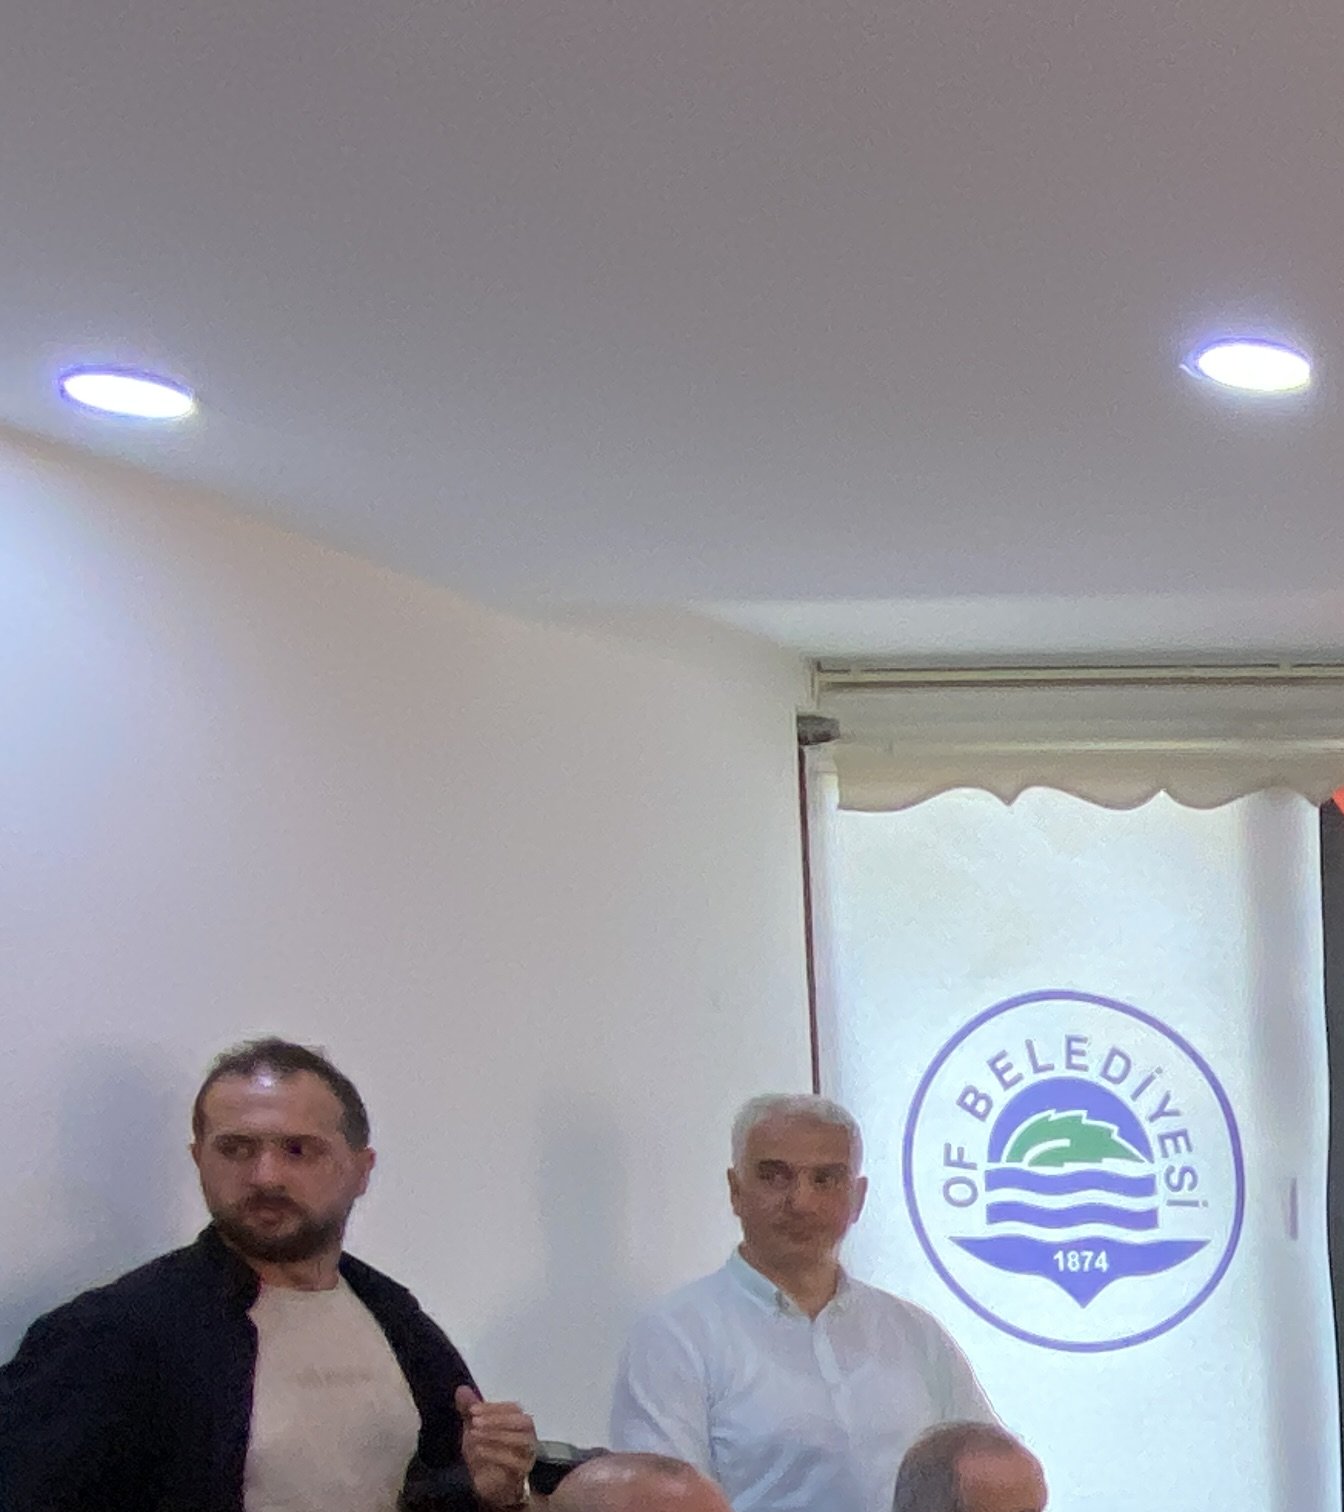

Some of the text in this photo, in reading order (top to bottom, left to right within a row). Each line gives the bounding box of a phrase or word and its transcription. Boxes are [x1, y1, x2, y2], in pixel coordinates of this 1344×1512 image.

[942, 1034, 1209, 1208] OF BELEDİYESİ
[1053, 1250, 1109, 1273] 1874
